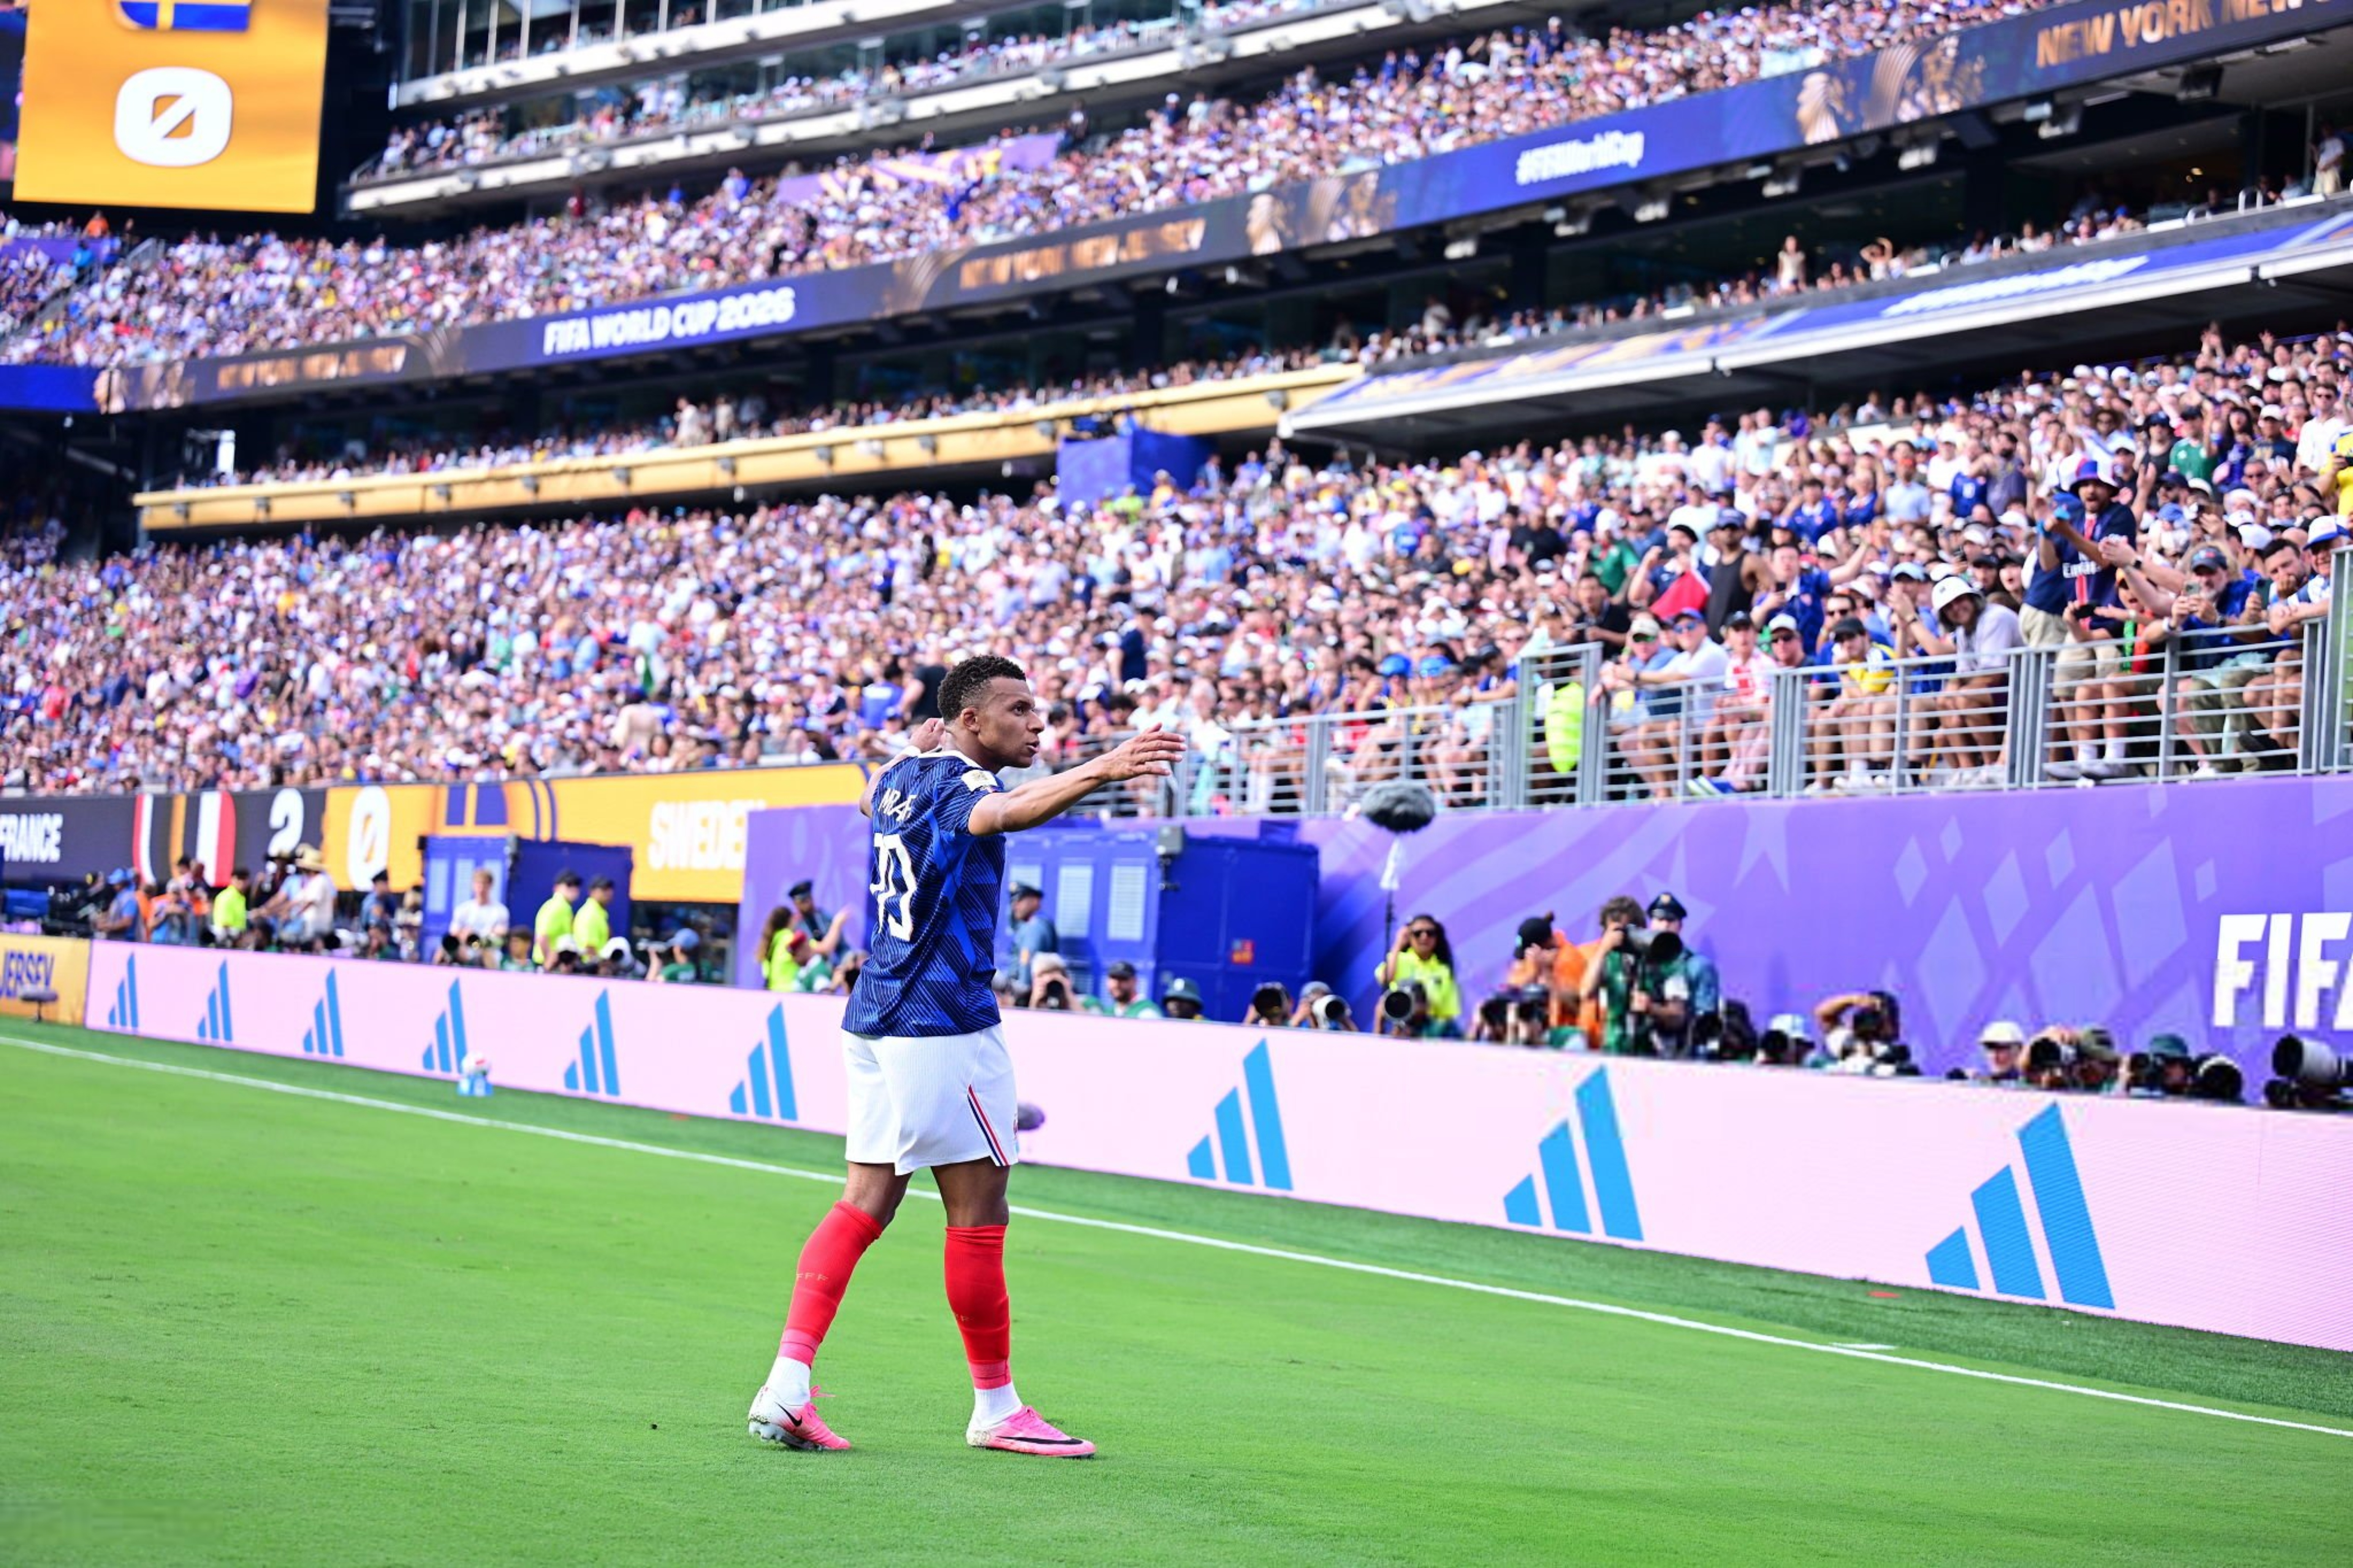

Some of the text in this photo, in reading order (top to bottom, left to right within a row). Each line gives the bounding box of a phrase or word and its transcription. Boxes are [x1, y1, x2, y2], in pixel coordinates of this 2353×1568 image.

[2036, 14, 2114, 68] NEW
[2120, 0, 2214, 47] YORK
[114, 66, 233, 167] 0
[543, 286, 796, 355] FIFA WORLD CUP 2026
[268, 788, 304, 857] 2
[346, 785, 391, 891] 0
[648, 799, 766, 870] SWEDE
